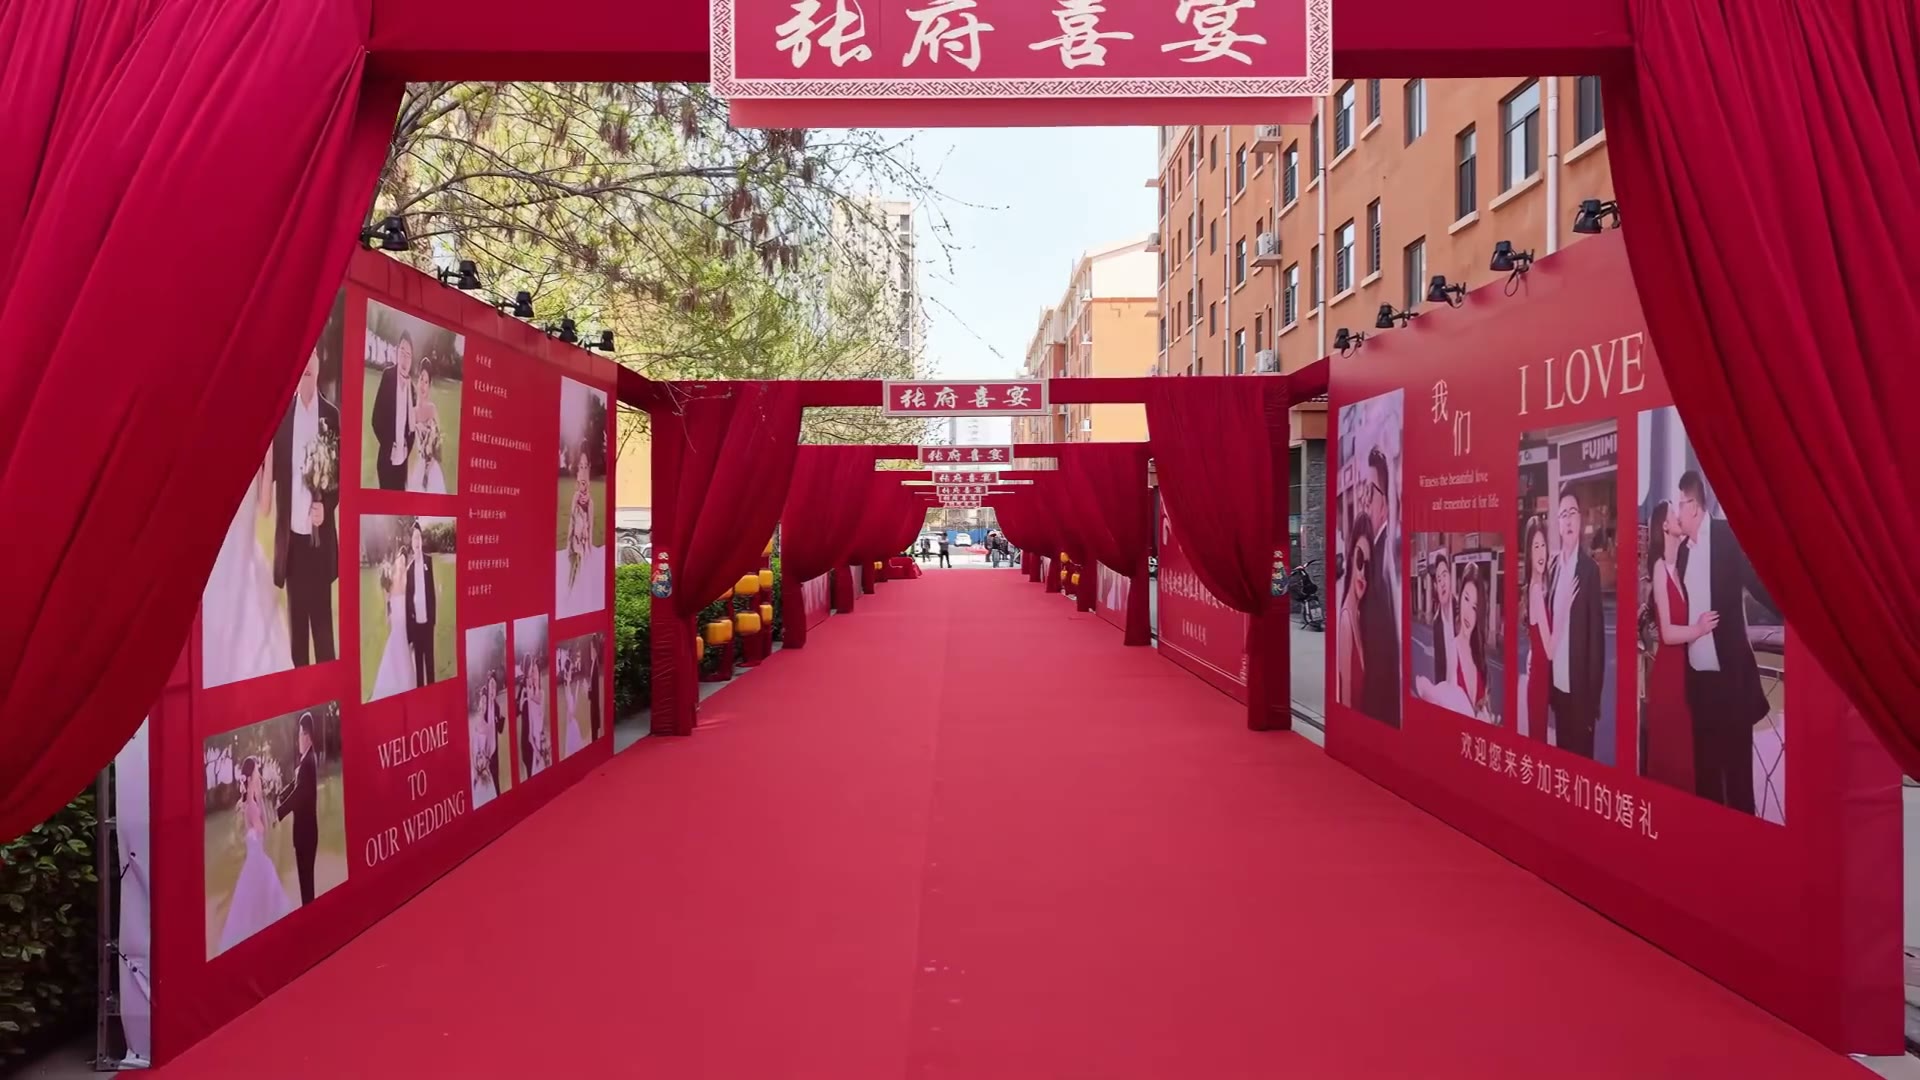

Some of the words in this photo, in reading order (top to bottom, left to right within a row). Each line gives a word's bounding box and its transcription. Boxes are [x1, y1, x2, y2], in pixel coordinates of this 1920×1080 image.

[775, 0, 1268, 71] 张府喜宴
[900, 386, 1032, 409] 张府喜宴
[1518, 364, 1530, 416] I
[1544, 331, 1646, 410] LOVE
[927, 448, 1004, 462] 张府喜宴
[377, 720, 449, 770] WELCOME
[407, 769, 428, 801] TO
[1459, 731, 1659, 840] 欢迎您来参加我们的婚礼
[365, 825, 401, 868] OUR
[402, 790, 466, 846] WEDDING
